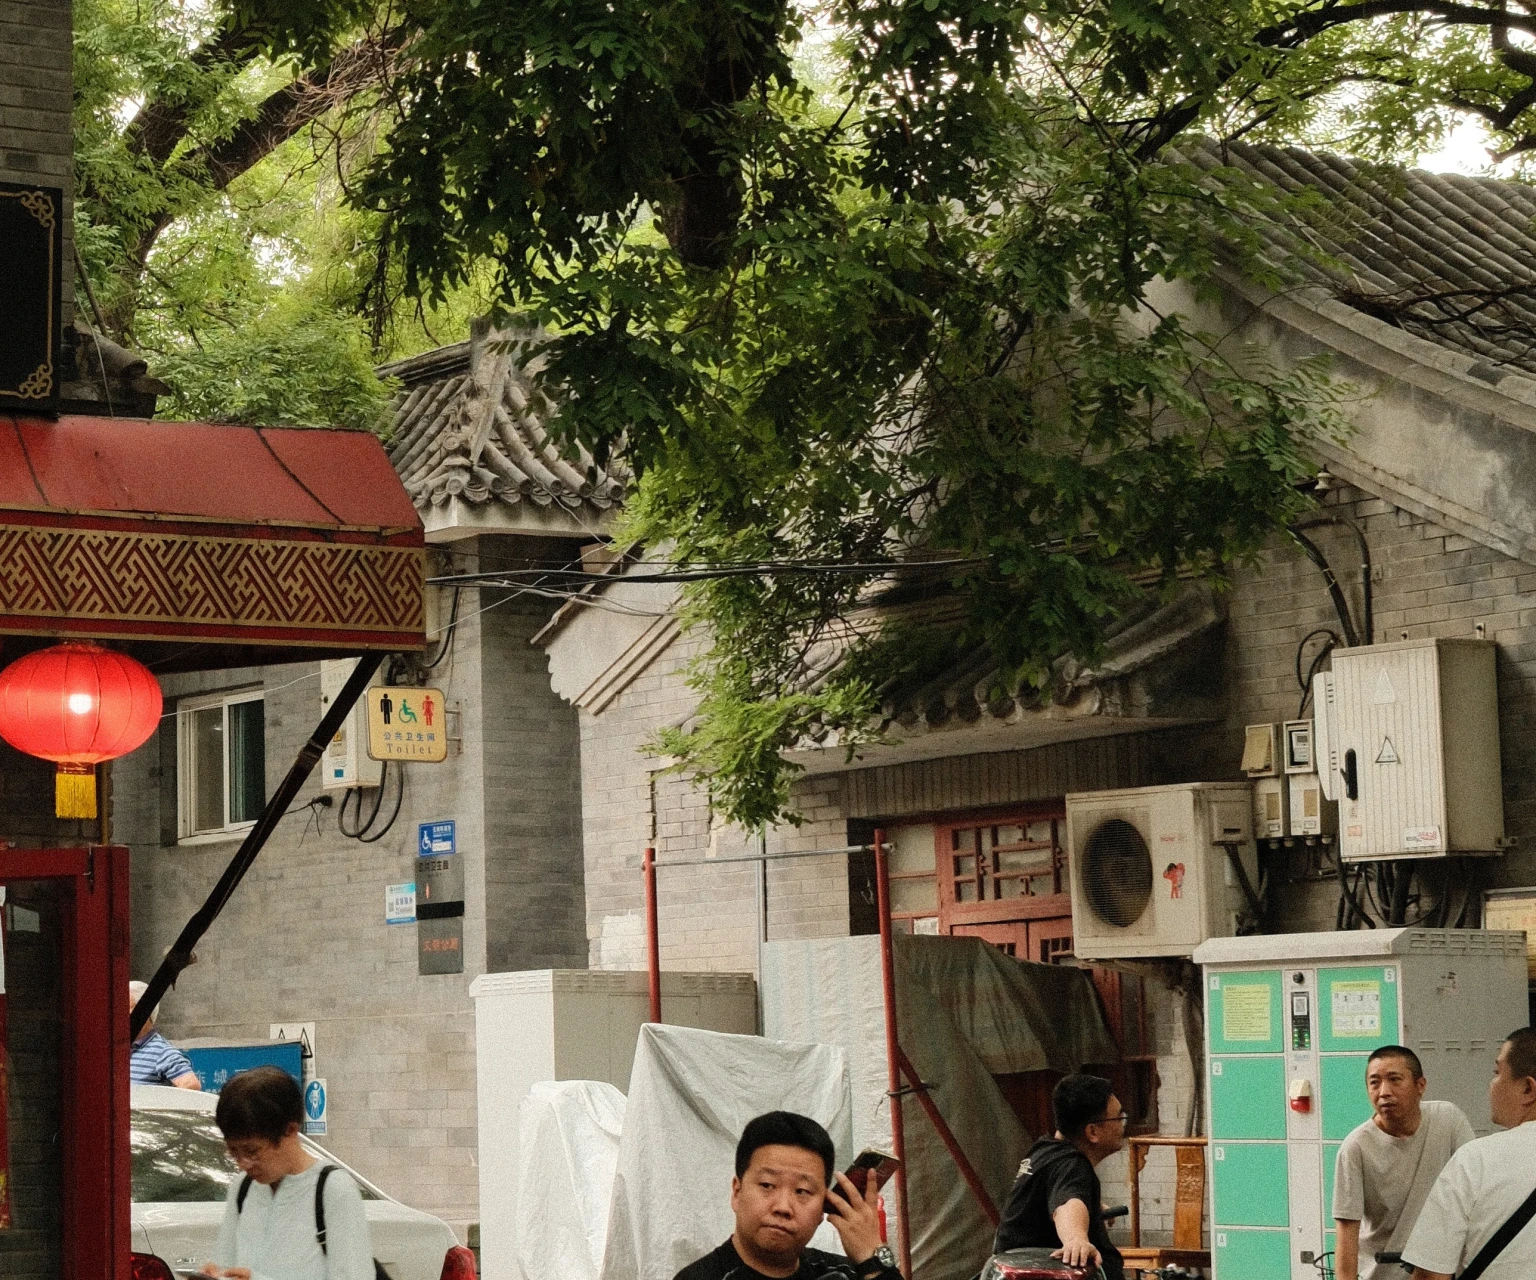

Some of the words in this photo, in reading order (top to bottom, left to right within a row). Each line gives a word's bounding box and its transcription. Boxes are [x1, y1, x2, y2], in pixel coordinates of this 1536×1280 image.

[384, 732, 435, 742] 公共卫生间
[386, 744, 432, 755] Toilet
